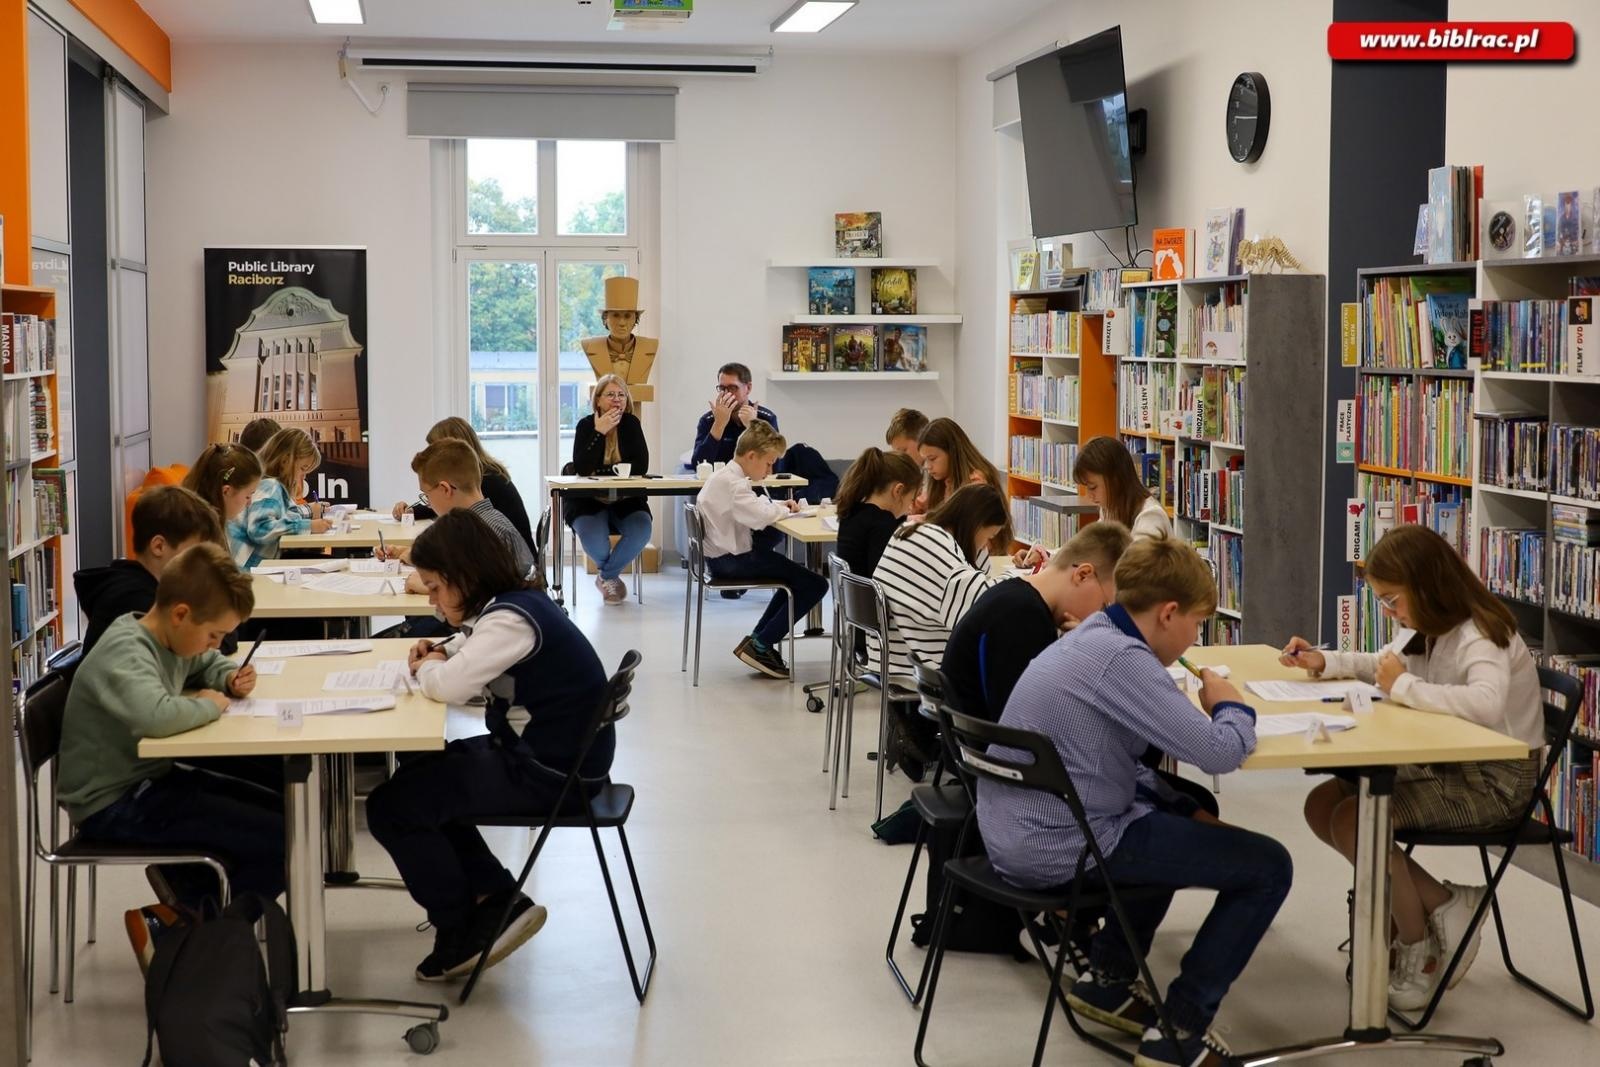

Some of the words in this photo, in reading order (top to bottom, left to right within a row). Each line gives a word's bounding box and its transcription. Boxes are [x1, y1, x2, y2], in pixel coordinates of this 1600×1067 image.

[228, 261, 268, 273] Public
[270, 261, 315, 275] Library
[228, 273, 284, 286] Raciborz
[1, 324, 10, 365] MANGA
[1195, 399, 1204, 440] DINOZAURY
[318, 473, 349, 499] In
[1342, 598, 1350, 635] SPORT
